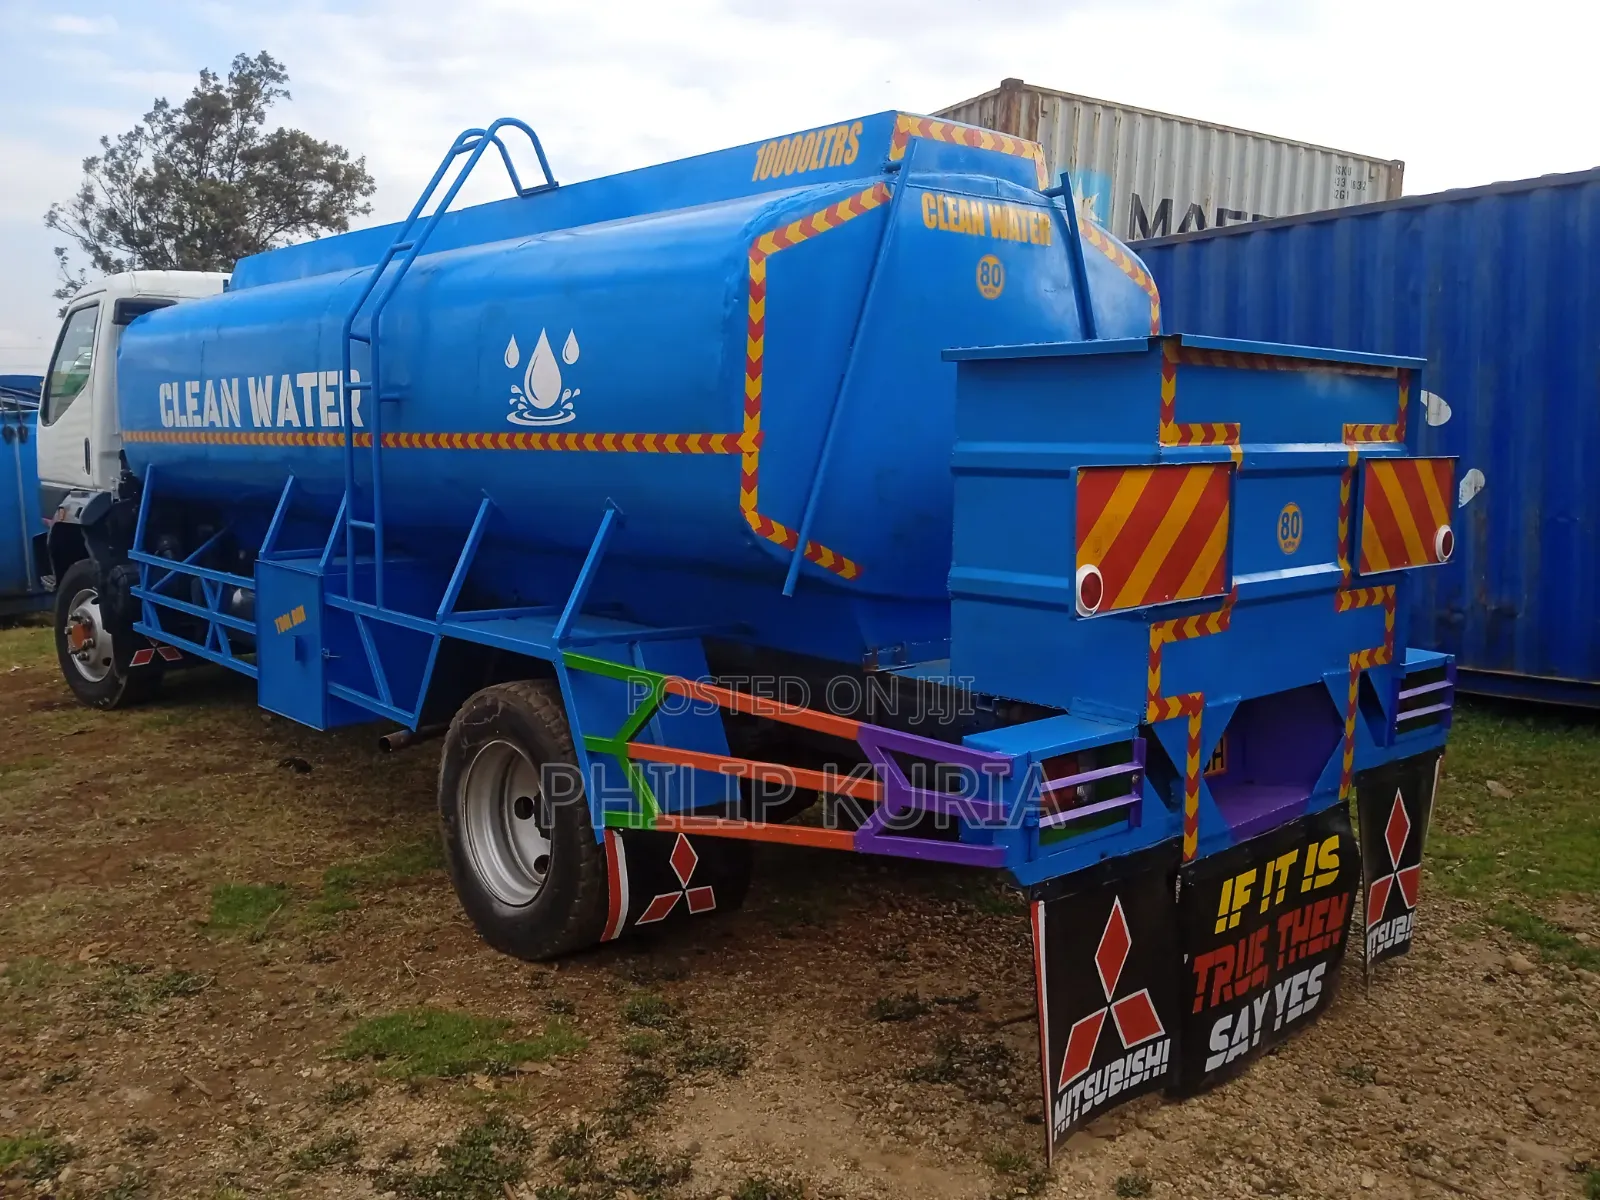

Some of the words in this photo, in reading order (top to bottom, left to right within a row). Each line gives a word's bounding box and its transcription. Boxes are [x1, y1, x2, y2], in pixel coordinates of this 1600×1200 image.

[752, 121, 862, 182] 10000LTRS
[921, 192, 985, 236] CLEAN
[988, 203, 1051, 246] WATER
[980, 261, 1001, 288] 80
[159, 377, 241, 428] CLEAN
[247, 369, 364, 428] WATER
[1281, 511, 1300, 540] 80
[1214, 868, 1257, 935] IF
[1259, 848, 1299, 915] IT
[1300, 834, 1340, 894] IS
[1192, 924, 1270, 1014] TRUE
[1276, 891, 1349, 972] THEN
[1205, 988, 1271, 1073] SAY
[1273, 961, 1327, 1032] YES
[1053, 1038, 1171, 1143] MITSUBISHI
